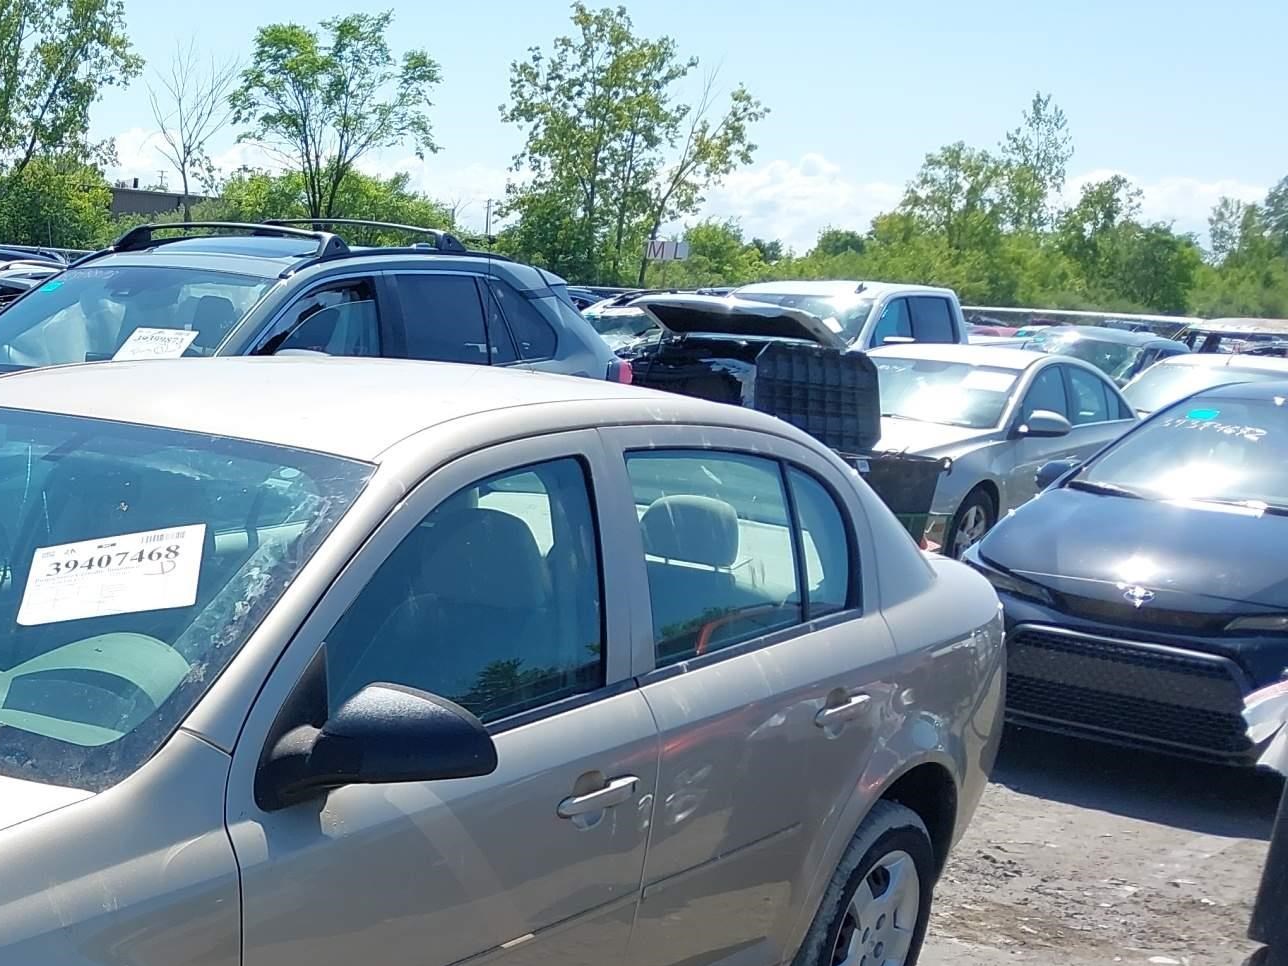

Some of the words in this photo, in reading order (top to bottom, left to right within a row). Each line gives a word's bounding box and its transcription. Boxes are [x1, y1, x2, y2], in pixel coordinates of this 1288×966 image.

[648, 241, 665, 259] M
[673, 242, 683, 260] L
[46, 544, 180, 576] 39407468
